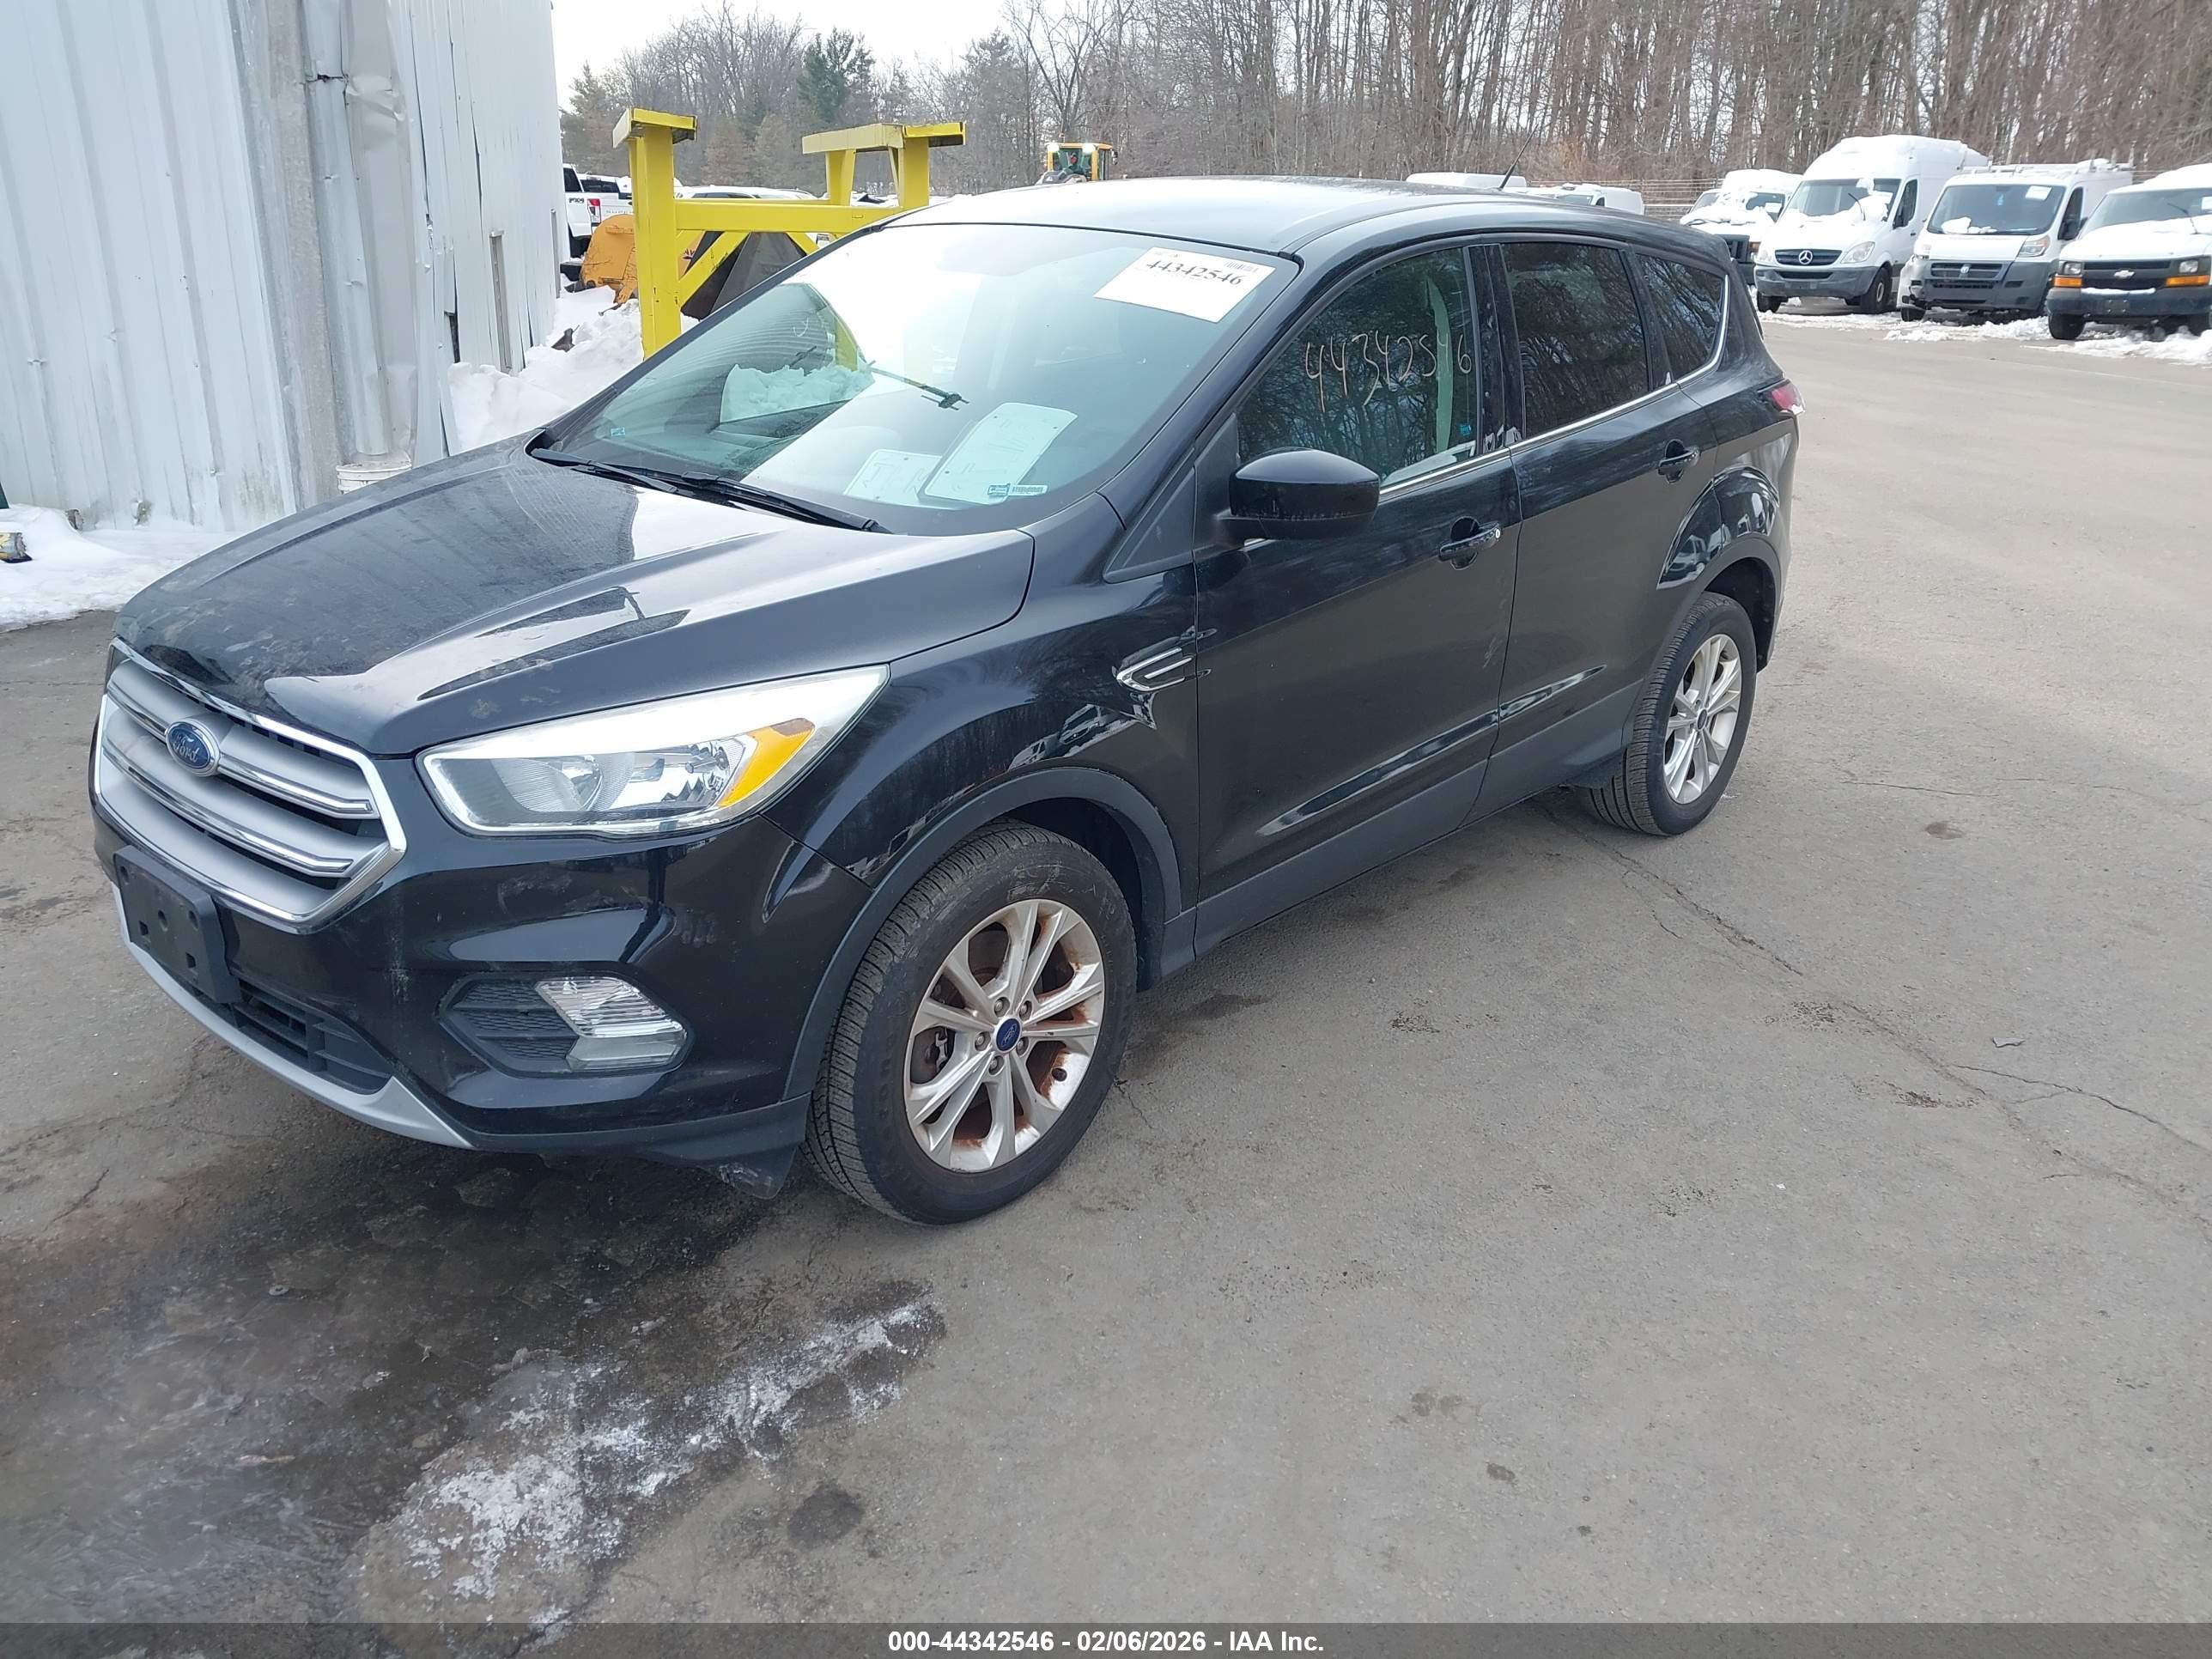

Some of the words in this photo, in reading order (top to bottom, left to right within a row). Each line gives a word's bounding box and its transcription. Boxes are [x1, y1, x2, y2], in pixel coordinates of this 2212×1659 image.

[1146, 260, 1245, 286] 44342546
[1305, 330, 1472, 413] 44342546
[173, 734, 201, 763] Ford
